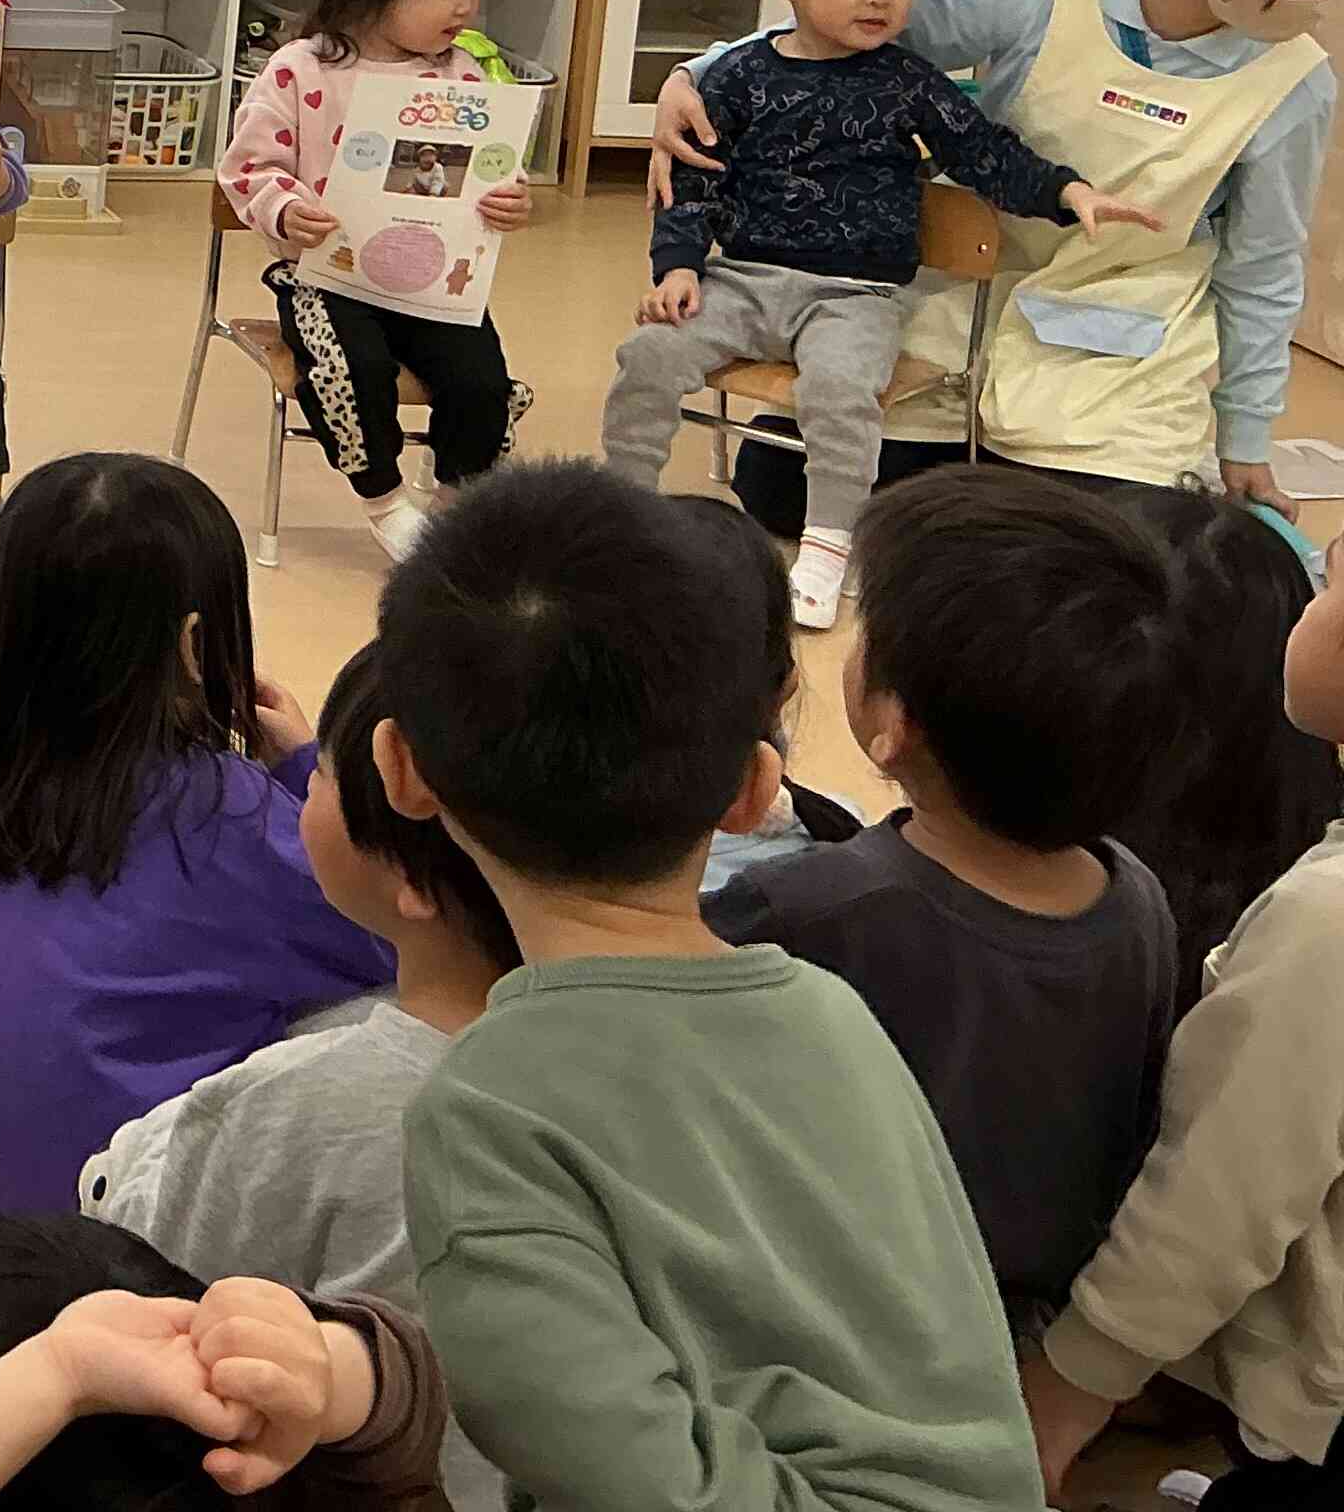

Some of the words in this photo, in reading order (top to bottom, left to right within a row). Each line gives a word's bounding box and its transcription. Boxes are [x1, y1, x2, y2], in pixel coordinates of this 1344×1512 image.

[398, 104, 490, 131] おめでとう
